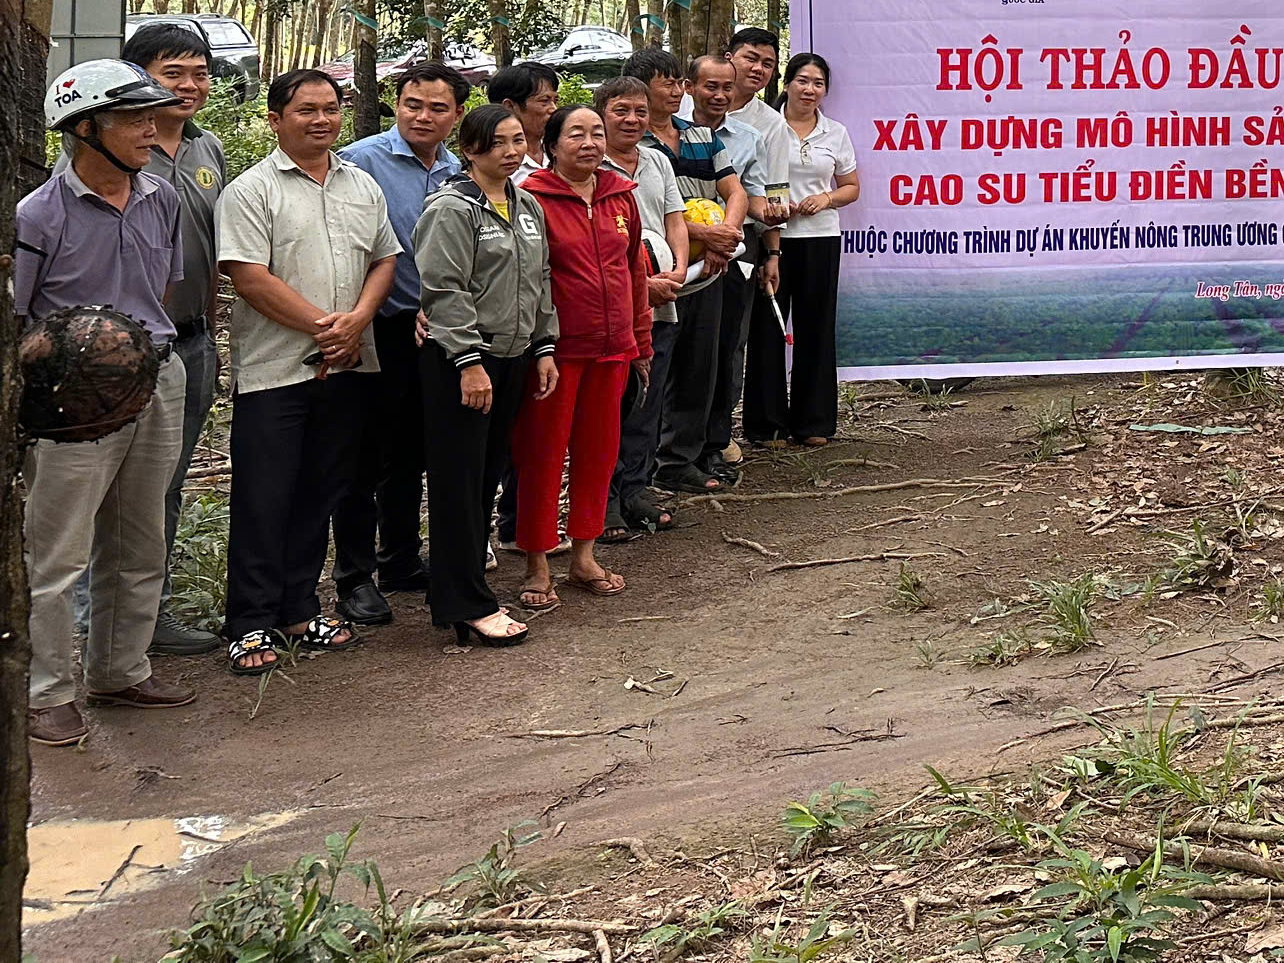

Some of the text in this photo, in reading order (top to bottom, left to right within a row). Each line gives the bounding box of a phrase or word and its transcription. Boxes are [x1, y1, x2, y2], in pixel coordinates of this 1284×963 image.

[936, 33, 1023, 103] HỘI
[1039, 30, 1171, 90] THẢO
[1187, 24, 1284, 90] ĐẦU
[54, 89, 83, 108] TOA
[872, 112, 948, 151] XÂY
[960, 115, 1063, 156] DỰNG
[1076, 110, 1133, 148] MÔ
[1146, 110, 1231, 147] HÌNH
[889, 174, 964, 206] CAO
[977, 173, 1026, 205] SU
[1038, 158, 1117, 203] TIỂU
[1128, 159, 1212, 201] ĐIỀN
[518, 213, 539, 236] G
[841, 225, 888, 259] HUỘC
[892, 228, 958, 254] CHƯƠNG
[963, 226, 1011, 254] TRÌNH
[1016, 226, 1039, 257] DỰ
[1041, 224, 1066, 252] ÁN
[1068, 219, 1130, 250] KHUYẾN
[1135, 221, 1178, 249] NÔNG
[1183, 223, 1232, 248] TRUNG
[1237, 221, 1277, 246] ƯƠNG
[1195, 281, 1230, 301] Long
[1233, 280, 1262, 299] Tân,
